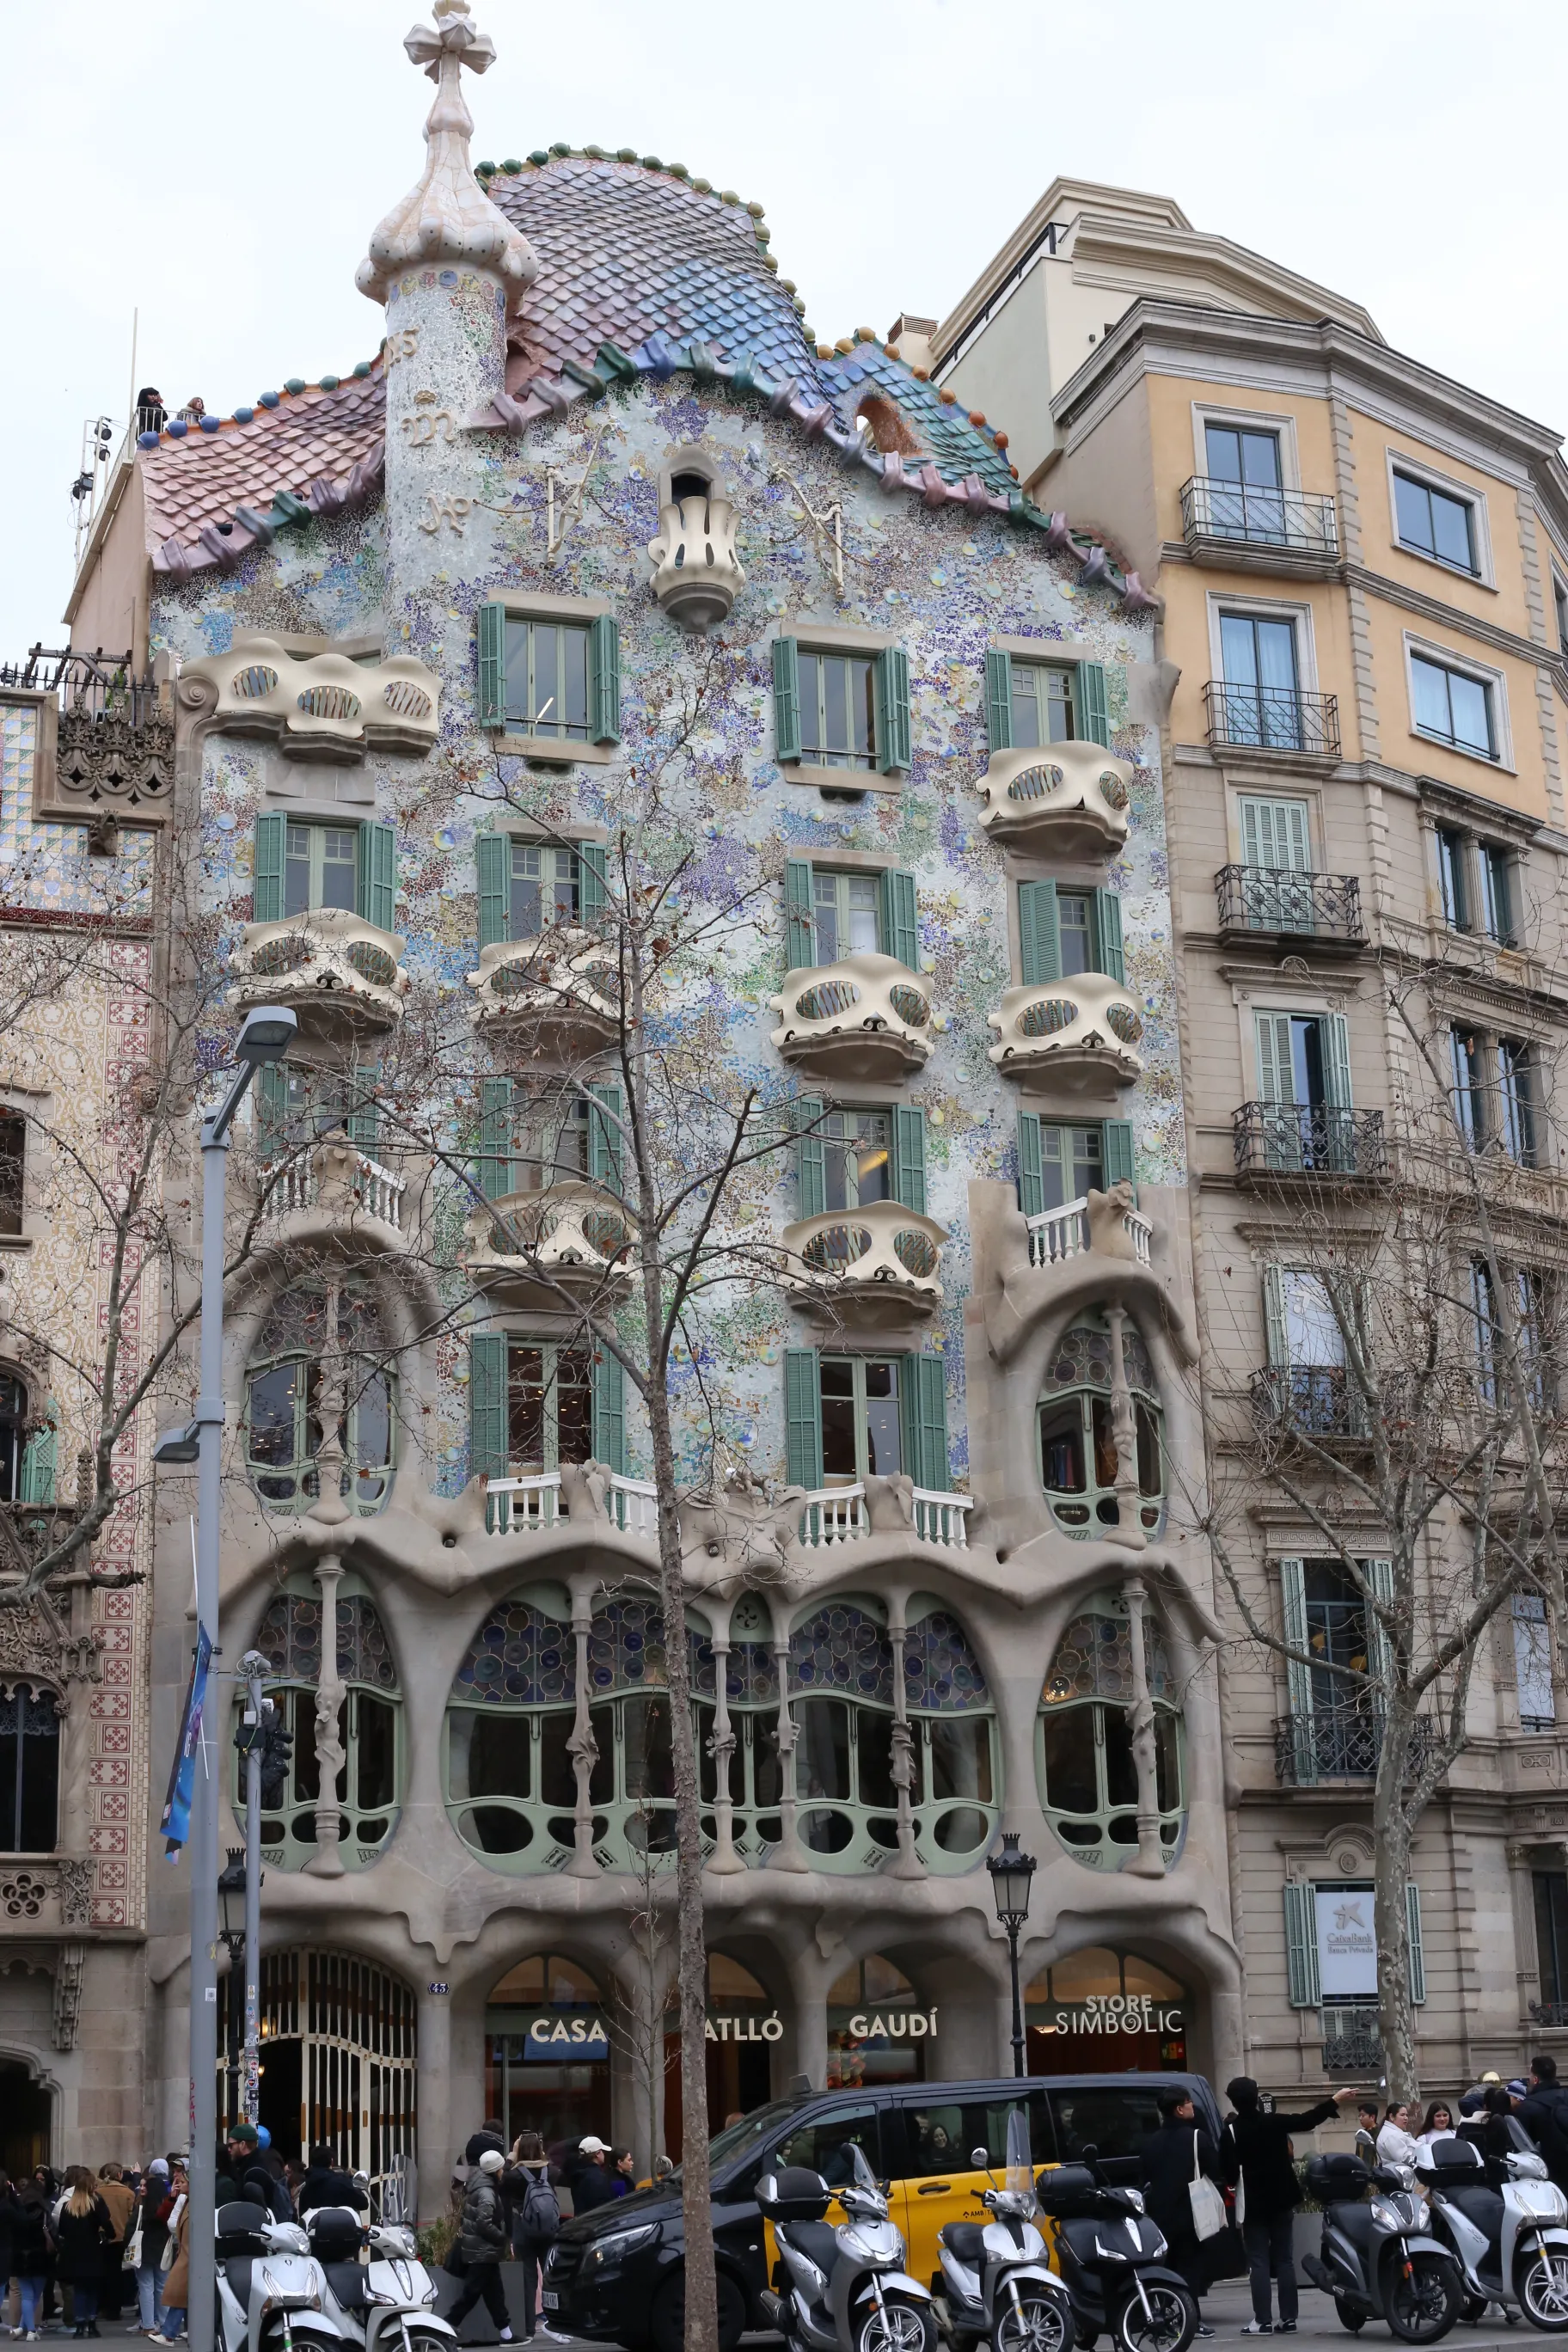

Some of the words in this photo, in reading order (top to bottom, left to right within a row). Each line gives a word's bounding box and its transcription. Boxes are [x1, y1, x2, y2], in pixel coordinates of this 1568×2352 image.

[1326, 1932, 1373, 1943] CaixaBank
[432, 1983, 446, 1993] 43
[1086, 1994, 1153, 2013] STORE
[530, 2018, 608, 2043] CASA
[705, 2010, 783, 2042] ATLLÓ
[849, 2006, 938, 2037] GAUDÍ
[1056, 2010, 1183, 2034] SIMBOLIC
